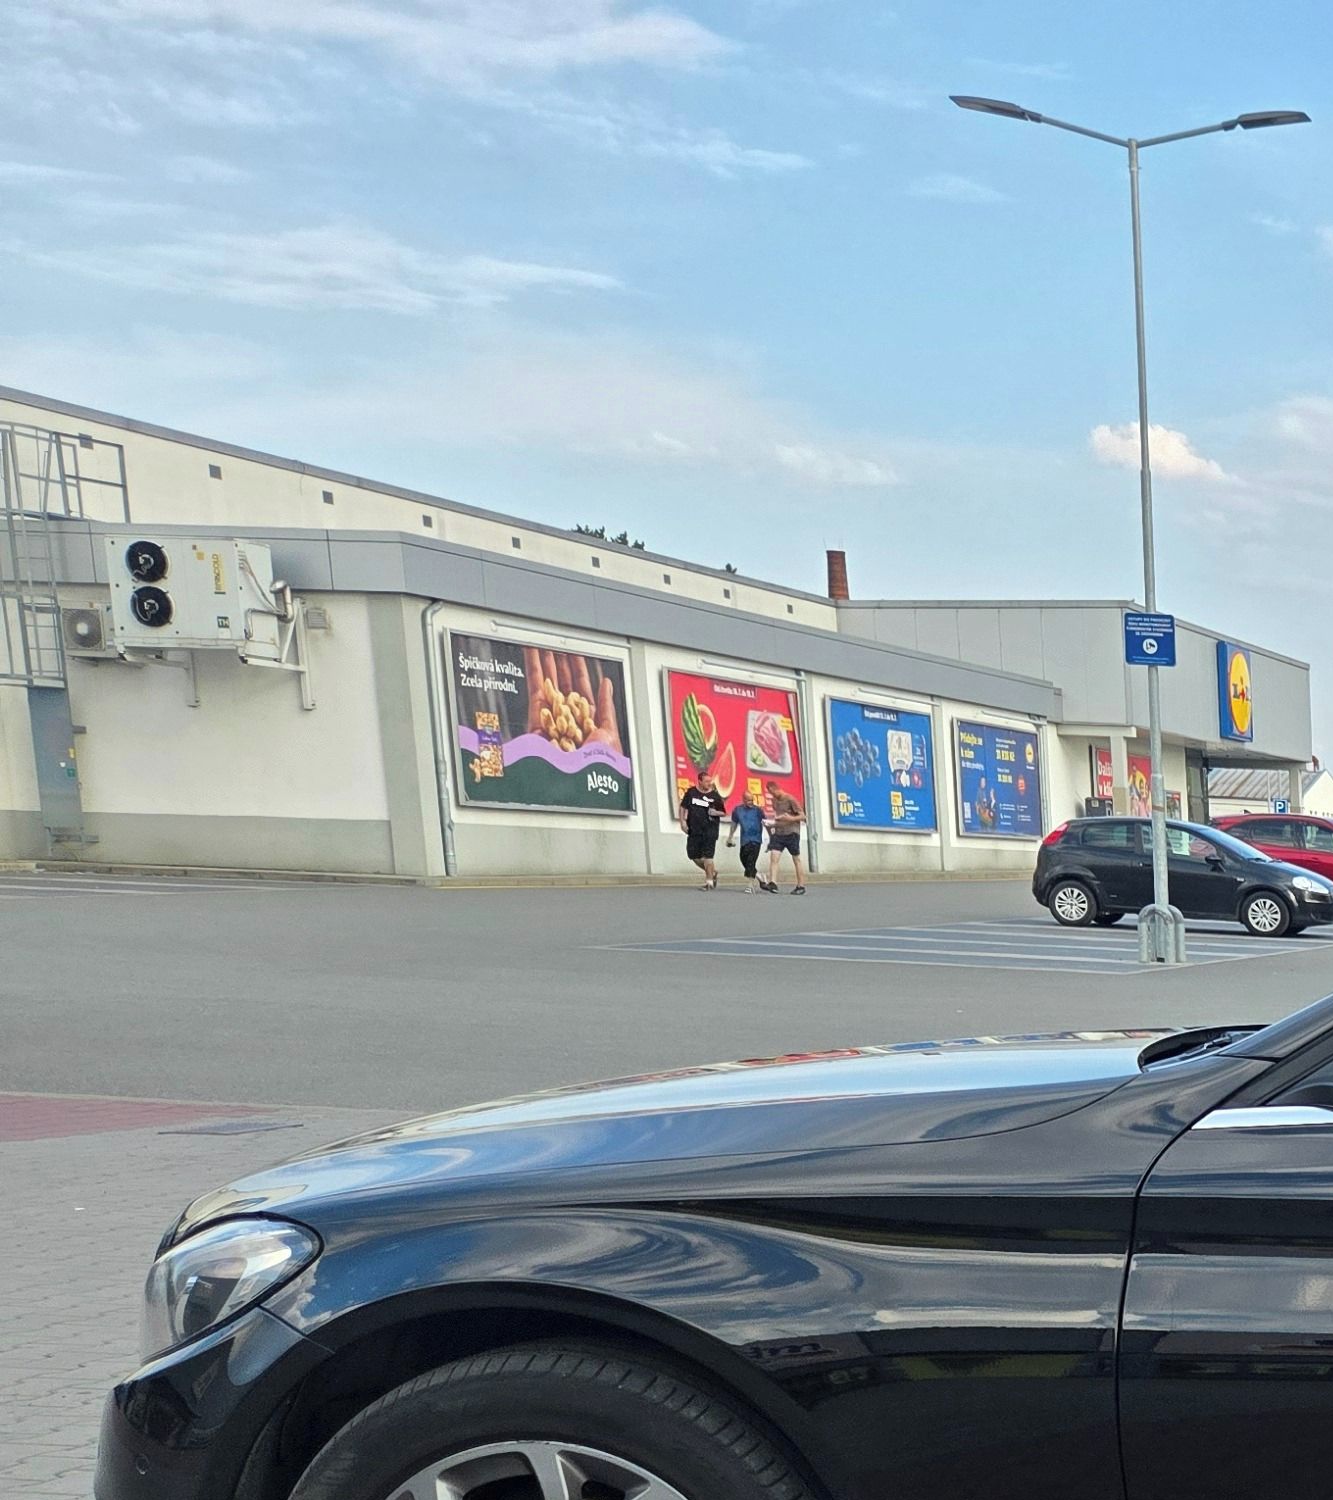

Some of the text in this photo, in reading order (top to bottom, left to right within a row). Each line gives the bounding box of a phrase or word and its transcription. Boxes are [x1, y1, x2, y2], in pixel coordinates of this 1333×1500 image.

[458, 652, 494, 672] Špičková
[460, 673, 483, 688] Zcela
[587, 770, 619, 793] Alesto
[1276, 801, 1284, 813] P
